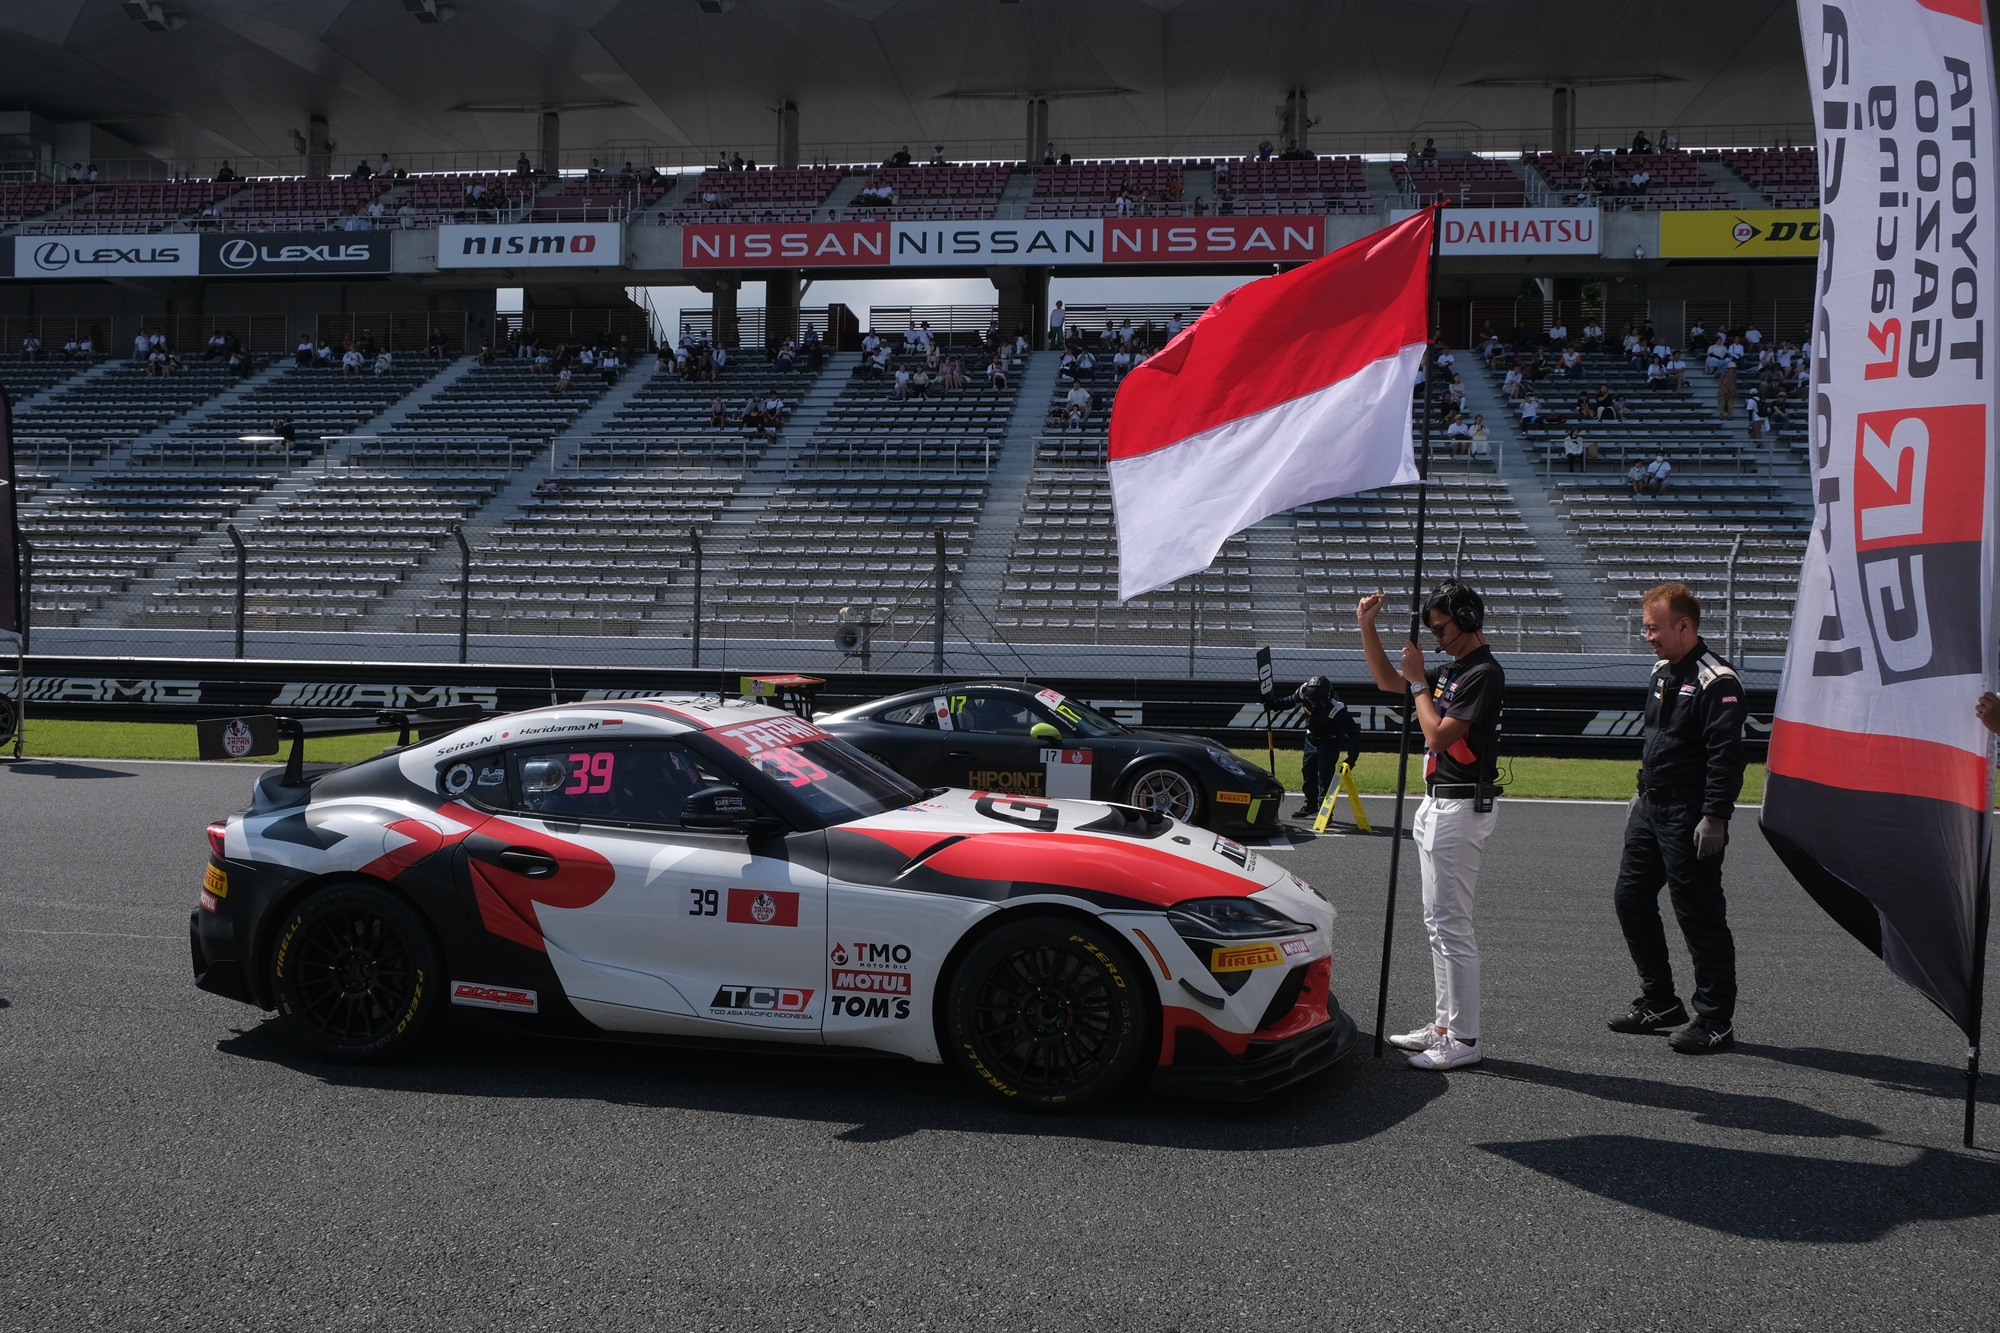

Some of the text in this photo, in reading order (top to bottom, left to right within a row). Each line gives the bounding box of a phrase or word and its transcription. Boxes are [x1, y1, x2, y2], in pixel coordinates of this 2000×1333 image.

[900, 230, 1094, 254] NISSAN
[1112, 226, 1314, 252] NISSAN
[1445, 219, 1592, 244] DAIHATSU
[75, 248, 180, 263] LEXUS
[262, 245, 370, 262] LEXUS
[463, 234, 596, 254] nismo
[692, 232, 882, 259] NISSAN
[1260, 663, 1272, 695] GO
[51, 679, 202, 703] AMG
[342, 684, 497, 710] AMG
[951, 695, 967, 714] 17
[519, 724, 585, 735] Haridarma
[226, 737, 250, 746] JAPAN
[231, 745, 245, 753] CUP
[1045, 750, 1057, 762] 17
[565, 752, 614, 795] 39
[761, 748, 828, 788] 39
[968, 771, 1043, 787] HIPOINT
[689, 888, 719, 916] 39
[753, 906, 774, 914] JAPAN
[275, 915, 303, 978] PIRELLI
[853, 943, 911, 963] TMO
[1218, 946, 1279, 967] PIRELLI
[836, 972, 908, 992] MOTUL
[454, 984, 534, 1006] DIXCEL
[721, 986, 804, 1011] TCD
[832, 996, 911, 1020] TOM'S
[962, 1043, 1019, 1098] PIRELLI
